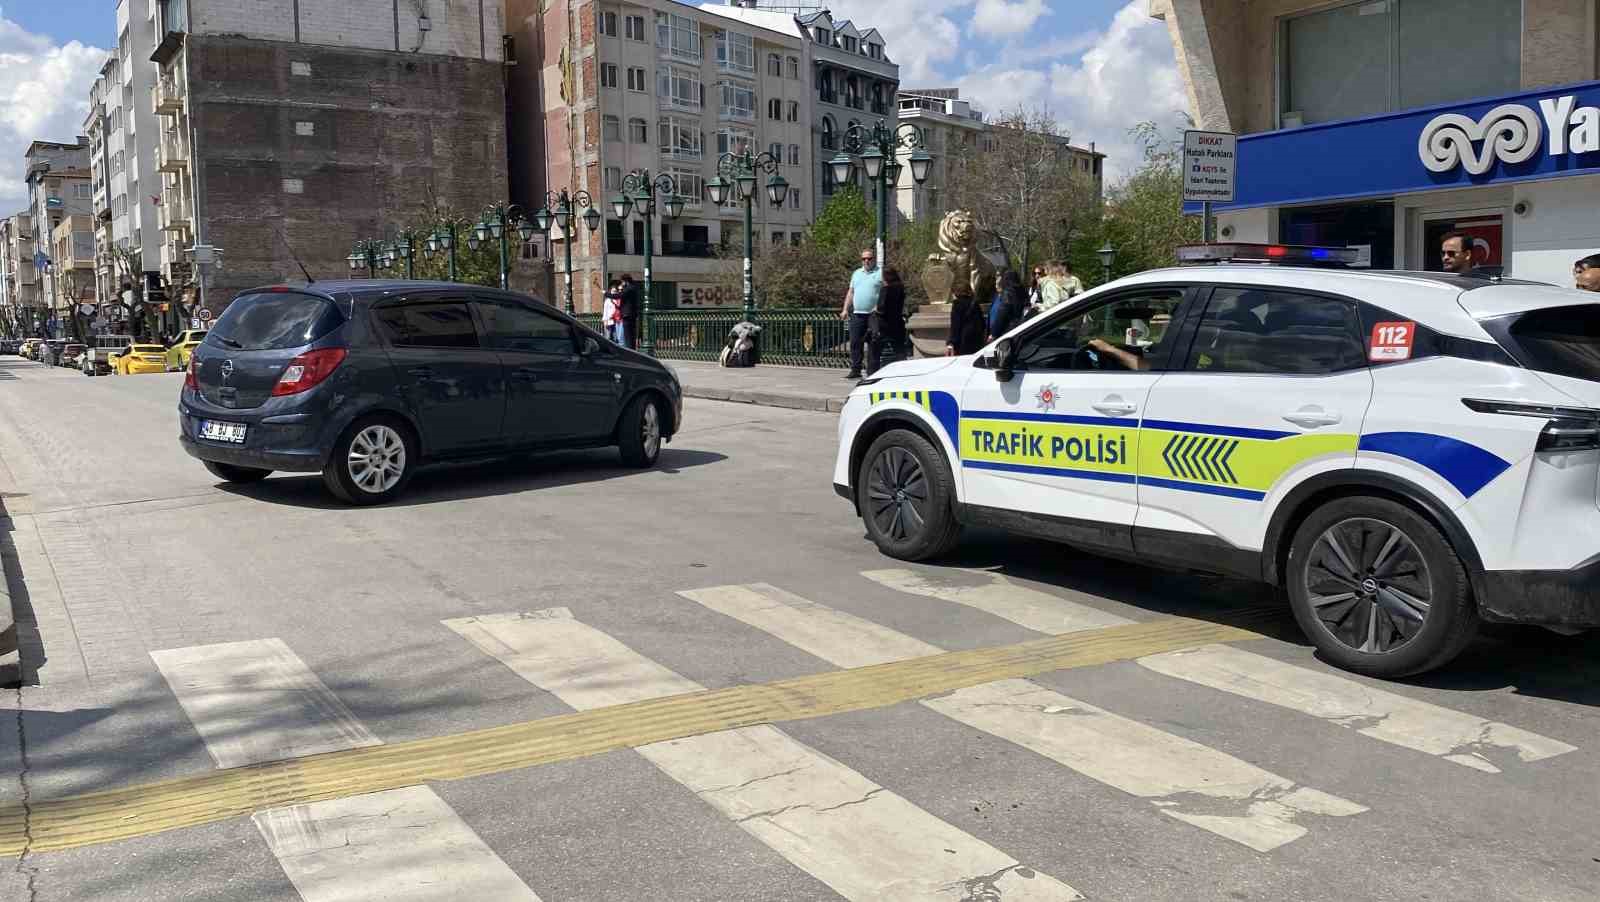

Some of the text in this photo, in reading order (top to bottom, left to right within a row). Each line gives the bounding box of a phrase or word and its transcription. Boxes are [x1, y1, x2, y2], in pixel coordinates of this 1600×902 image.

[1378, 326, 1408, 345] 112
[971, 427, 1127, 465] TRAFİK POLİSİ
